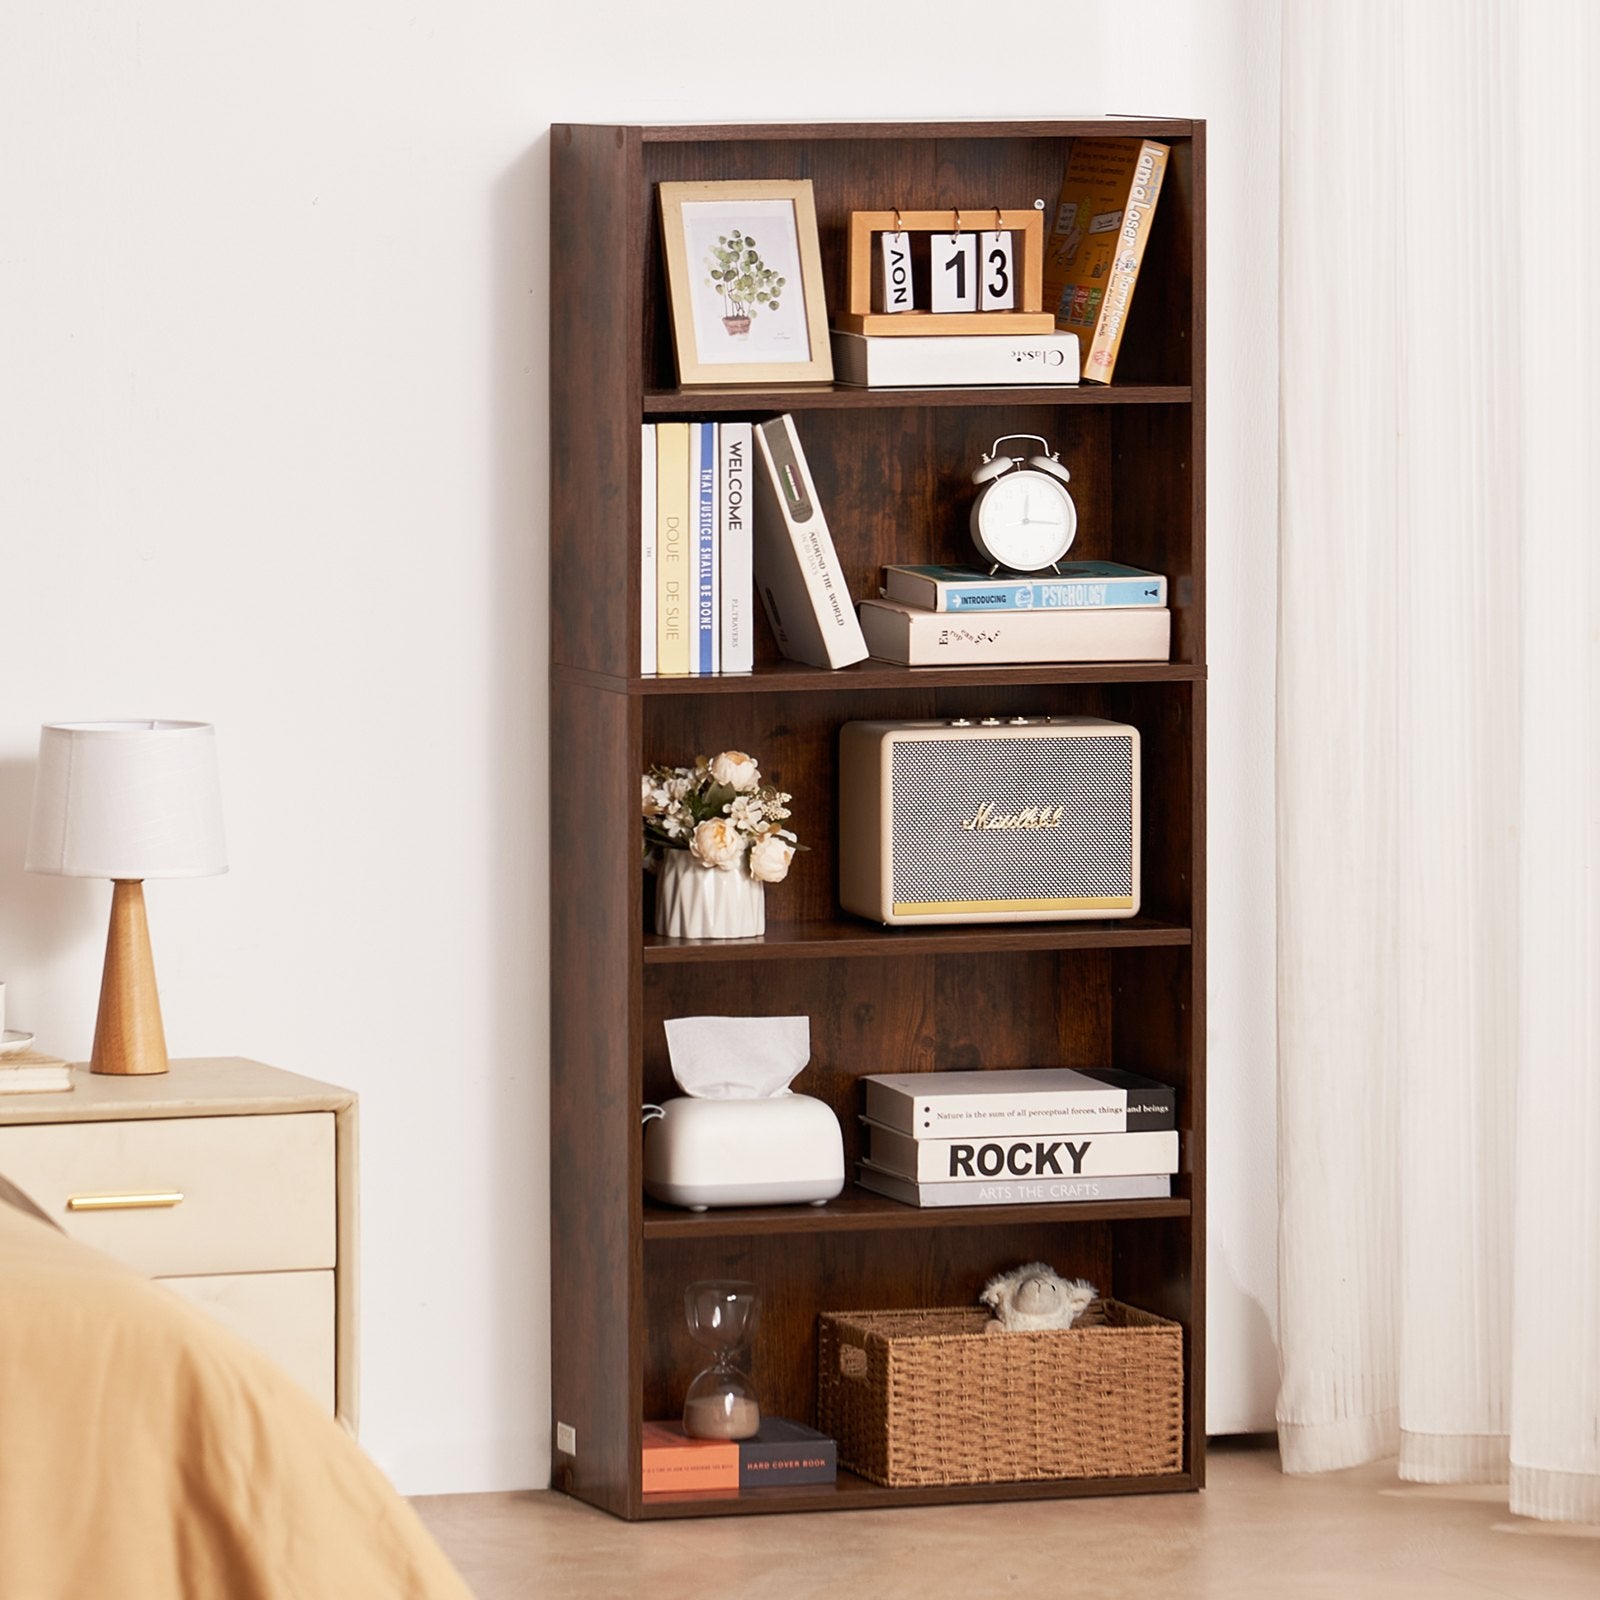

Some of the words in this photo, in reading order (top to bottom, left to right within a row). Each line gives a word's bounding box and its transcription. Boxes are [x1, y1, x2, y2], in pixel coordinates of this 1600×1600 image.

[1122, 200, 1151, 247] Loser
[888, 250, 908, 304] NOV
[1010, 349, 1064, 367] Classic
[700, 468, 712, 494] THAT
[729, 441, 743, 531] WELCOME
[700, 500, 712, 541] JUSTICE
[666, 516, 679, 562] DOUE
[700, 547, 712, 578] SHALL
[666, 581, 679, 605] DE
[700, 585, 712, 598] BE
[808, 531, 826, 570] AROUND
[821, 572, 832, 591] THE
[829, 592, 845, 627] WORLD
[960, 594, 1007, 606] INTRODUCING
[1041, 583, 1108, 607] PSYCHOLOGY
[666, 607, 679, 641] SUIE
[700, 601, 712, 630] DONE
[937, 1111, 964, 1120] Nature
[974, 1110, 987, 1118] the
[1007, 1108, 1015, 1117] of
[1016, 1108, 1027, 1117] all
[1028, 1107, 1069, 1118] perceptual
[1071, 1107, 1096, 1116] forces,
[1098, 1106, 1123, 1116] things
[1127, 1105, 1141, 1113] and
[1143, 1104, 1169, 1114] beings
[949, 1141, 1092, 1177] ROCKY
[979, 1186, 1012, 1199] ARTS
[1018, 1185, 1043, 1198] THE
[1051, 1183, 1099, 1197] CRAFTS
[747, 1462, 770, 1471] HARD
[772, 1460, 800, 1469] COVER
[803, 1459, 826, 1468] BOOK
